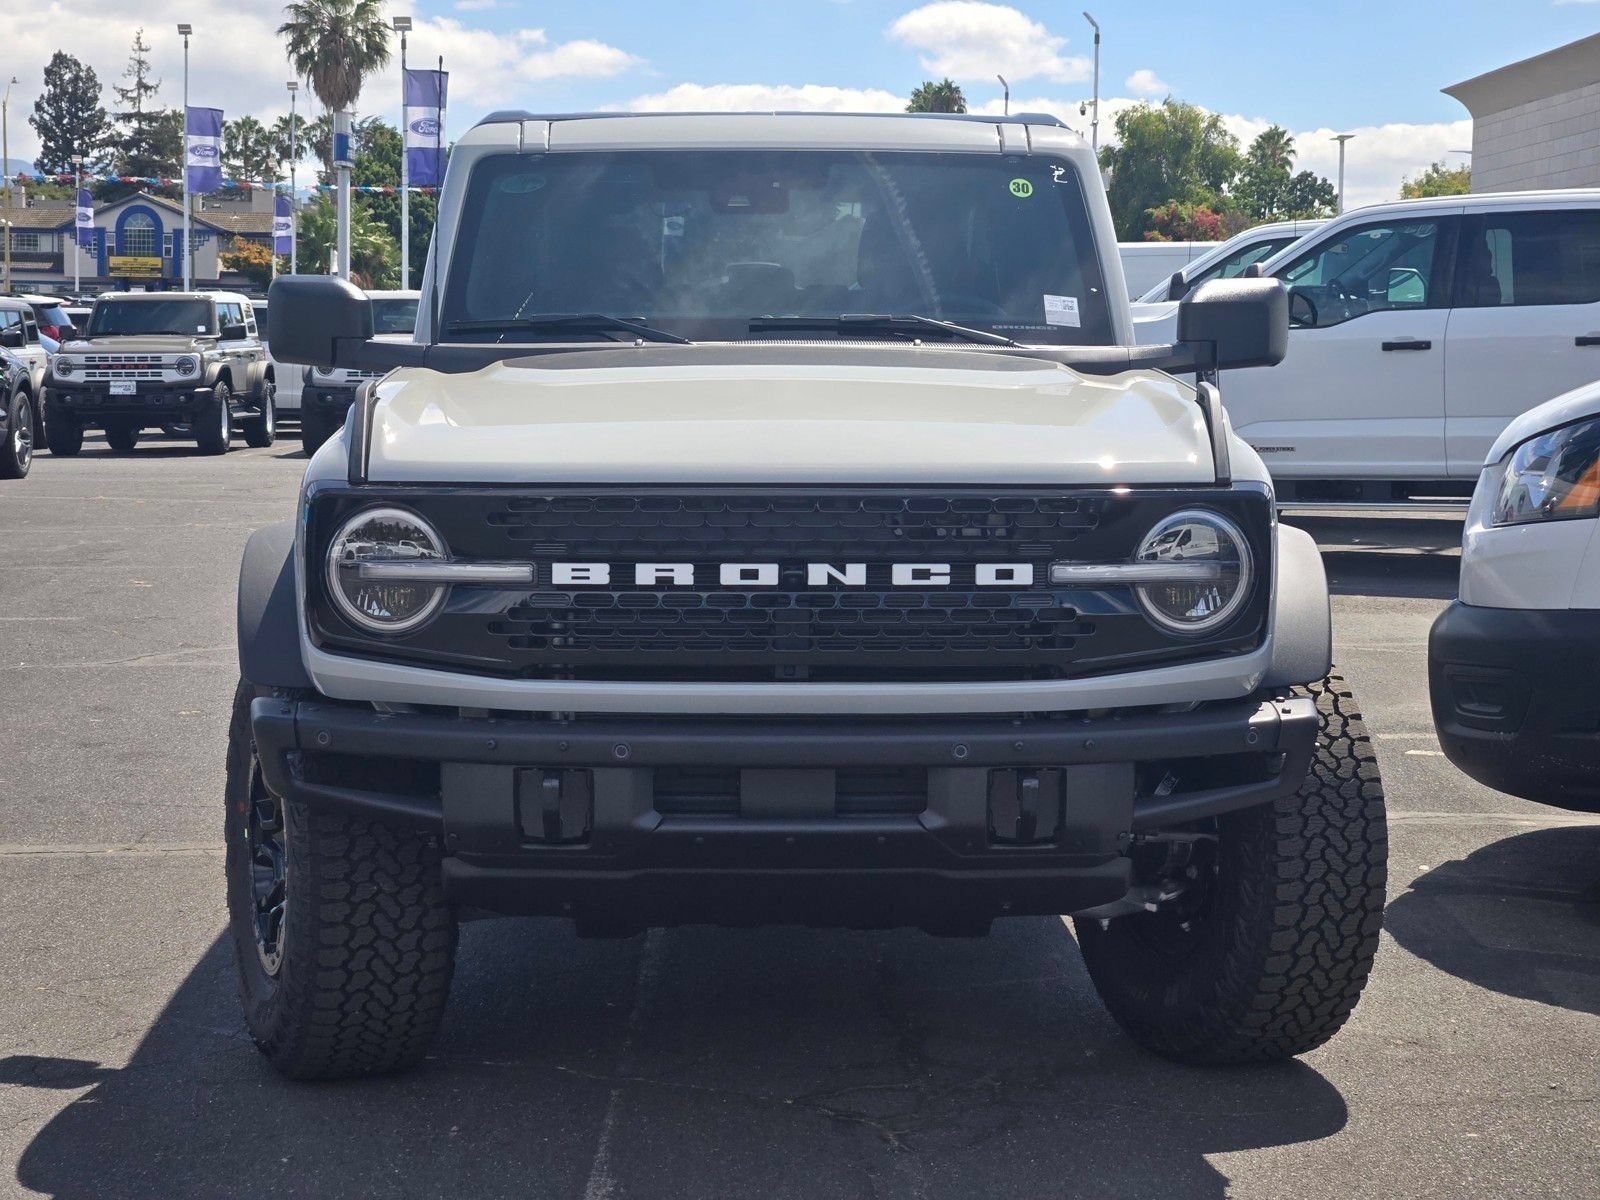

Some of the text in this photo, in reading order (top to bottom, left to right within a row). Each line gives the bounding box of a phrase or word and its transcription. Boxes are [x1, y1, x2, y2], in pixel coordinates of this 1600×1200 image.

[195, 146, 214, 155] Ford
[1012, 181, 1030, 194] 30
[551, 562, 1034, 586] BRONCO
